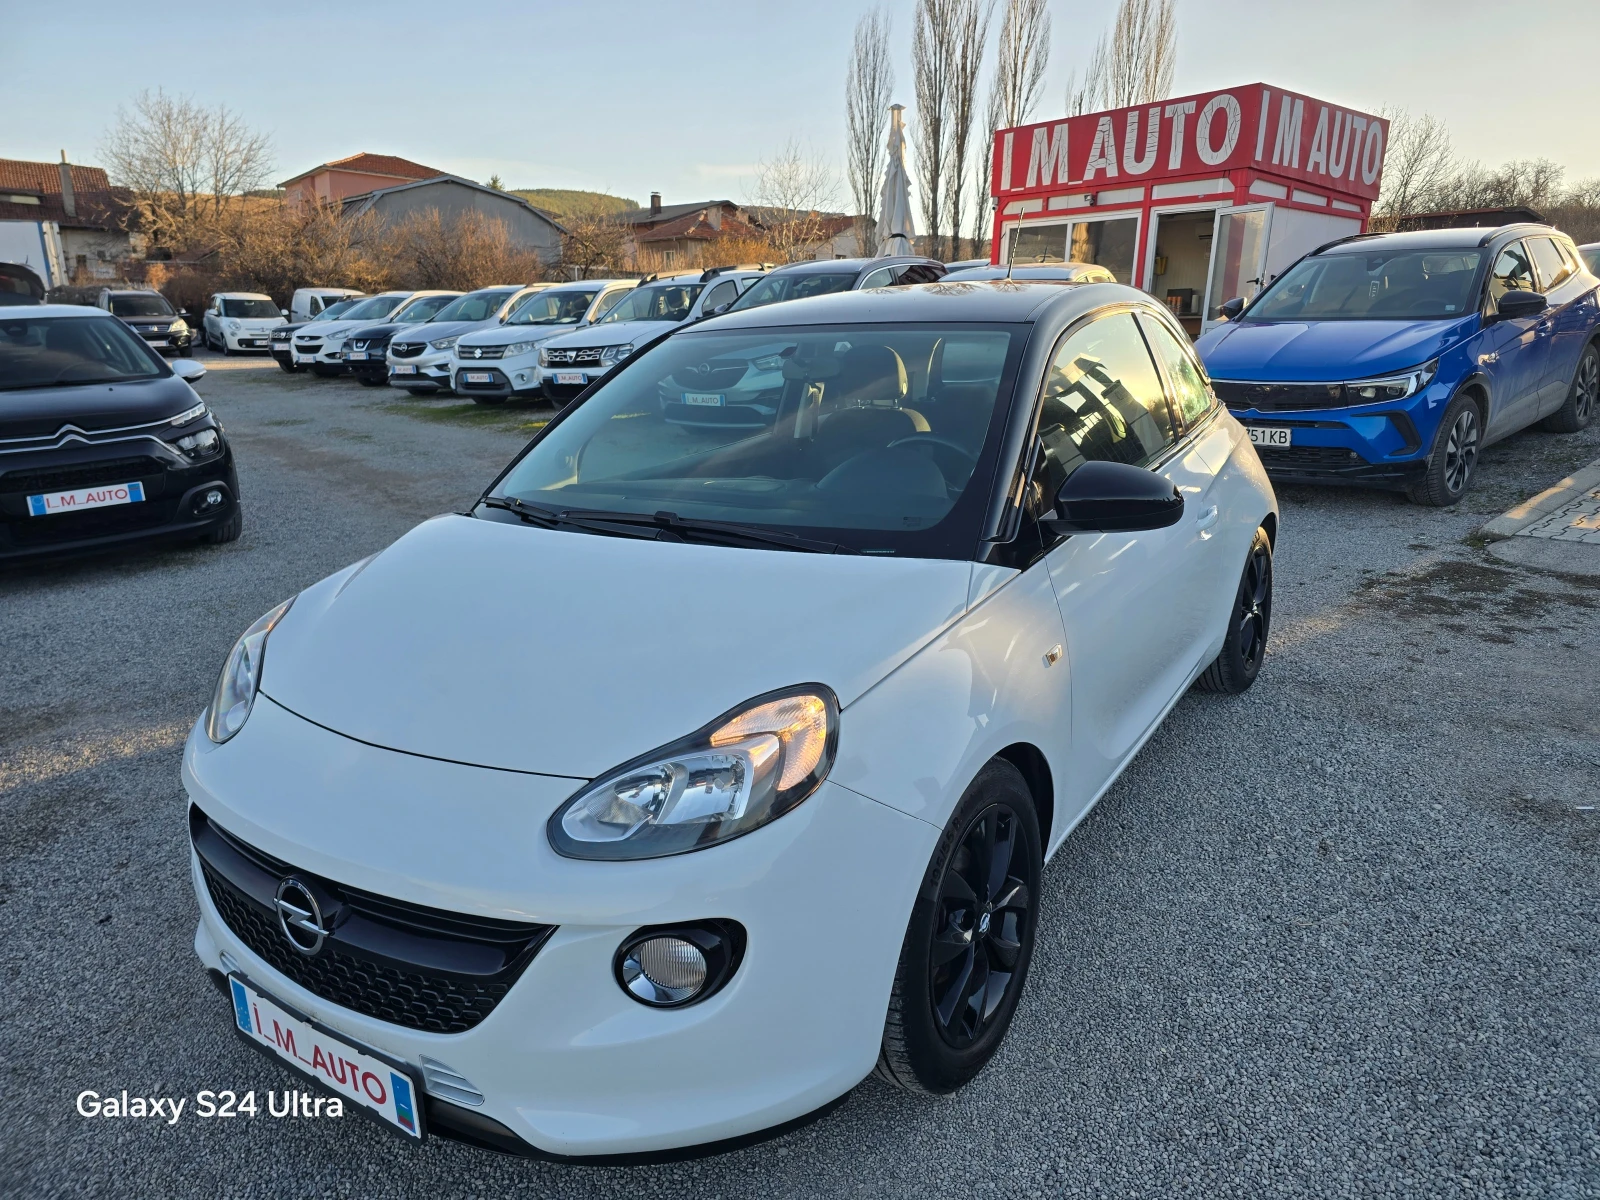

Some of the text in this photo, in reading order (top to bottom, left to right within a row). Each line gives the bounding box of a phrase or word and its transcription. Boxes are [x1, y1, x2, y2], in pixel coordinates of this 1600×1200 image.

[1254, 90, 1384, 187] I M AUTO
